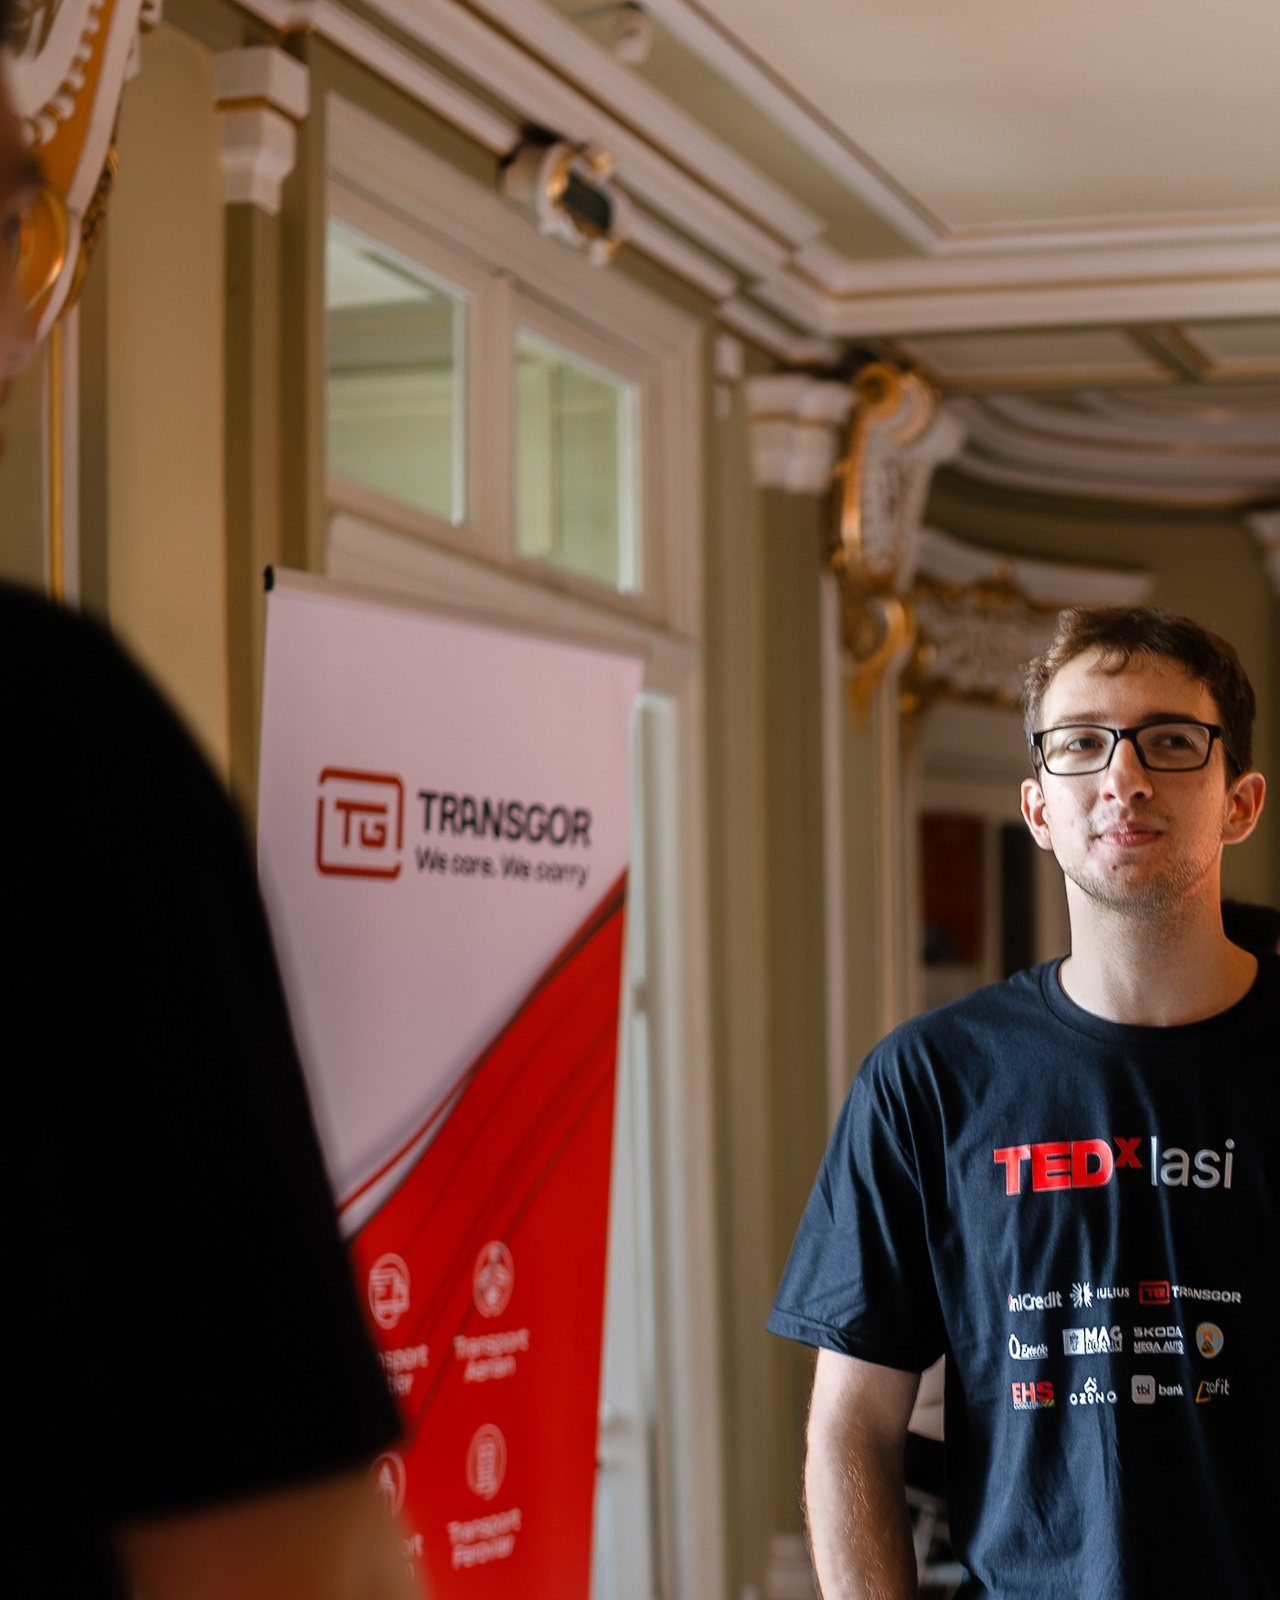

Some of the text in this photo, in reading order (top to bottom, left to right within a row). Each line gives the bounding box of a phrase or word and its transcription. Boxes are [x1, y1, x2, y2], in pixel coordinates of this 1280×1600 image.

[417, 790, 593, 848] TRANSGOR
[415, 846, 449, 876] We
[1011, 1381, 1054, 1403] EHS
[1158, 1383, 1184, 1396] bank
